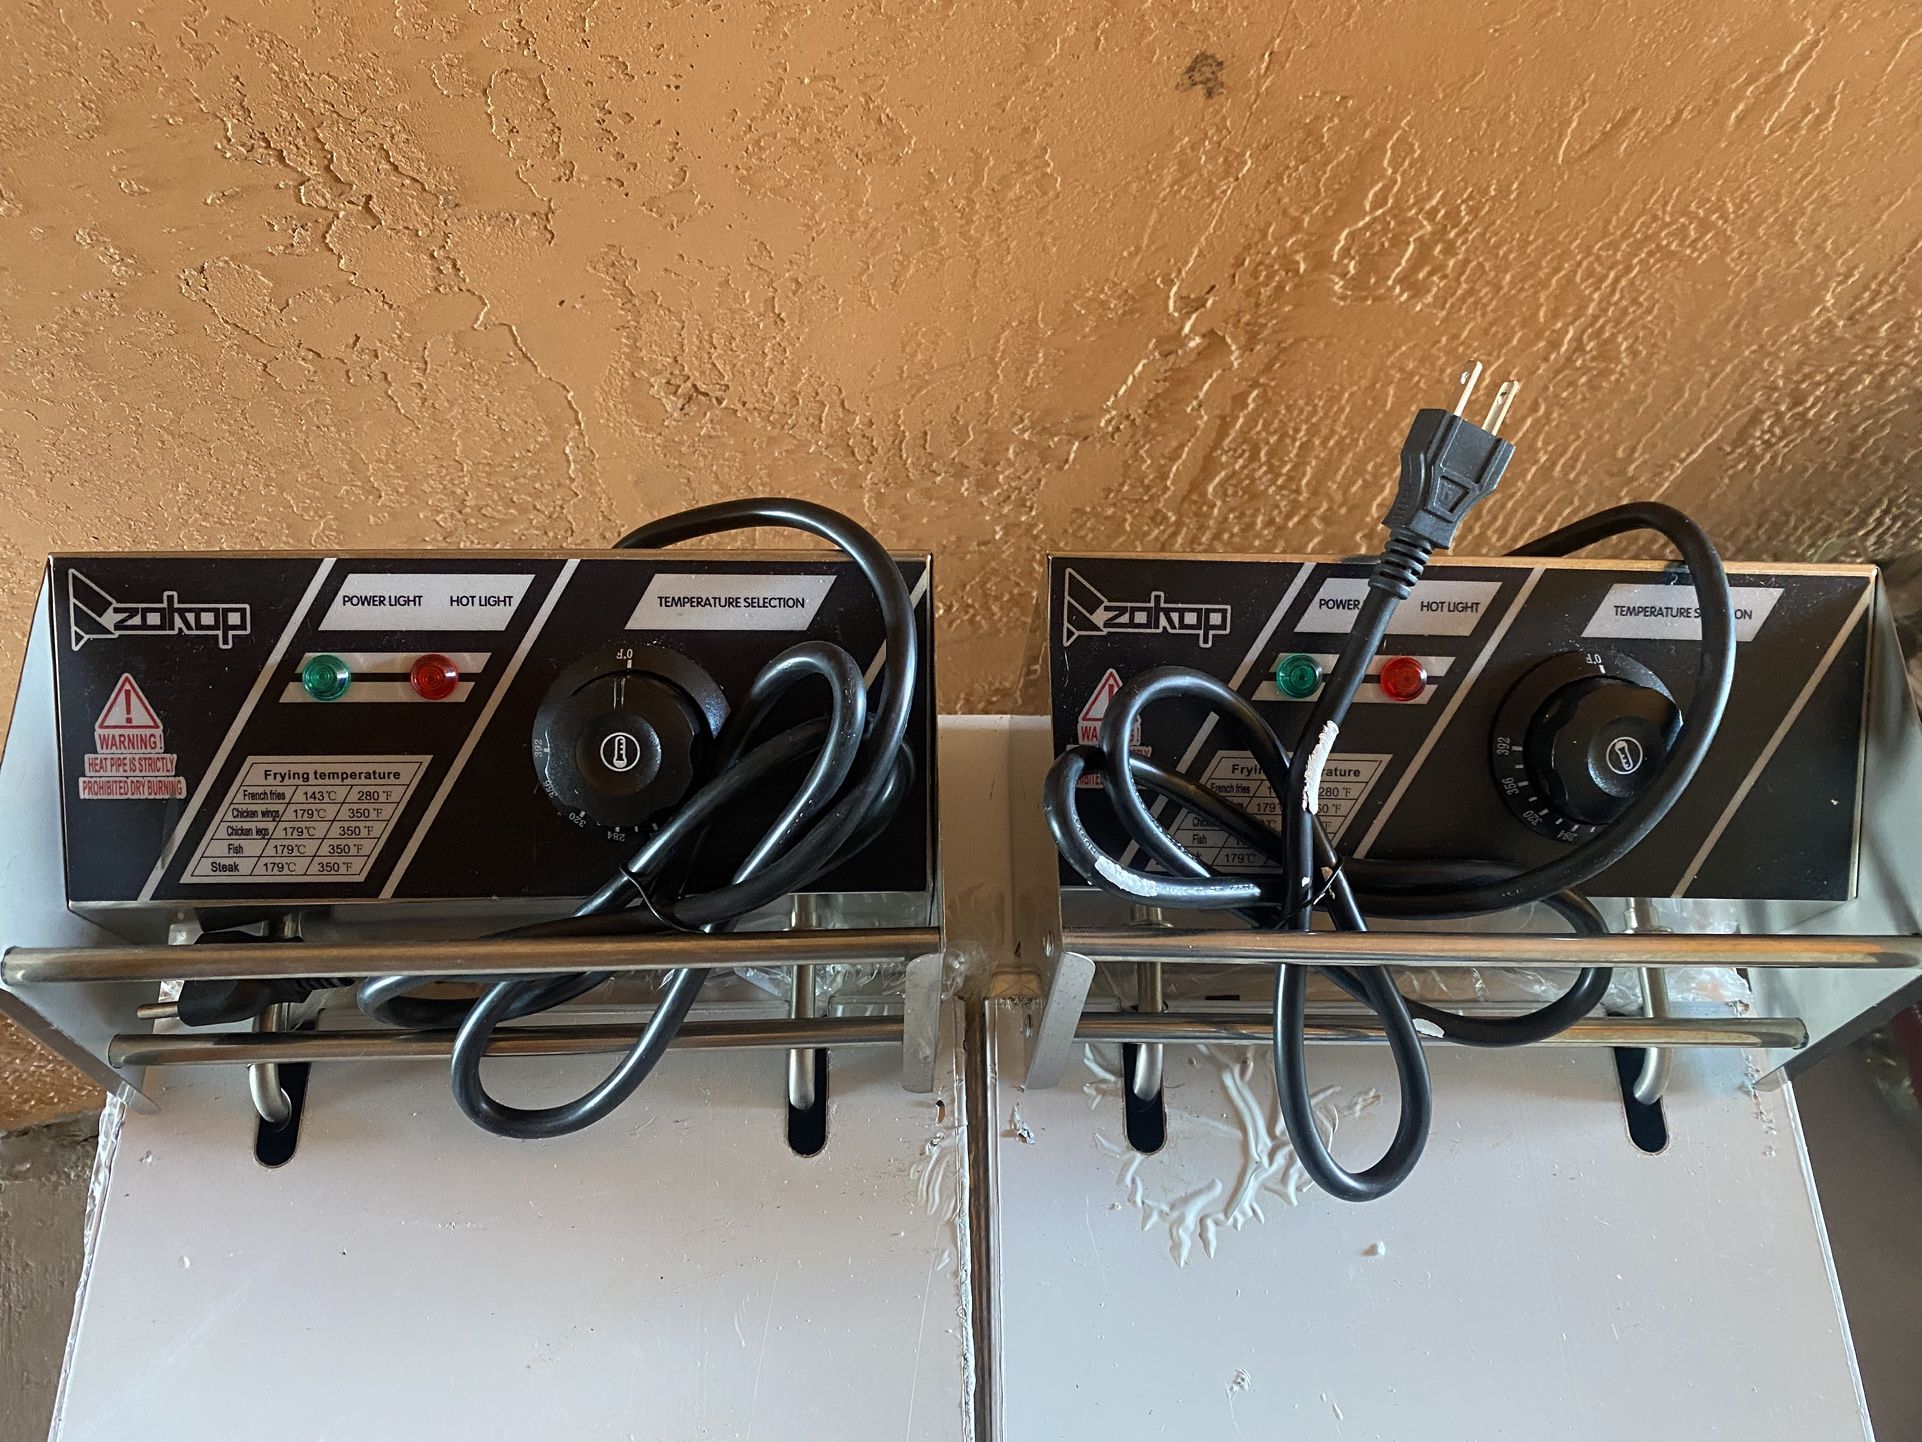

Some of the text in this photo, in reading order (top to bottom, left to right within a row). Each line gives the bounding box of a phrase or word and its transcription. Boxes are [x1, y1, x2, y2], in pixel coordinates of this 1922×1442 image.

[342, 595, 423, 607] POWER LIGHT
[450, 595, 514, 607] HOT LIGHT
[658, 596, 805, 609] TEMPERATURE SELECTION
[1319, 599, 1360, 610] POWER
[1420, 601, 1481, 613] HOT LIGHT
[1614, 605, 1692, 619] TEMPERATURE
[111, 591, 250, 649] zokop
[1102, 591, 1231, 648] zokop
[1496, 737, 1510, 756] 392
[88, 756, 175, 773] HEAT PIPE IS STRICTLY
[264, 769, 401, 783] Frying temperature
[83, 780, 182, 796] PROHIBITED DRY BURNING
[1234, 783, 1250, 794] fries
[1502, 777, 1520, 795] 356
[243, 790, 286, 800] French fries
[232, 808, 280, 821] Chicken wings
[568, 812, 587, 828] 320
[1522, 810, 1543, 826] 320
[226, 826, 270, 838] Chicken legs
[1192, 834, 1208, 845] Fish
[228, 844, 244, 855] Fish
[210, 862, 240, 873] Steak
